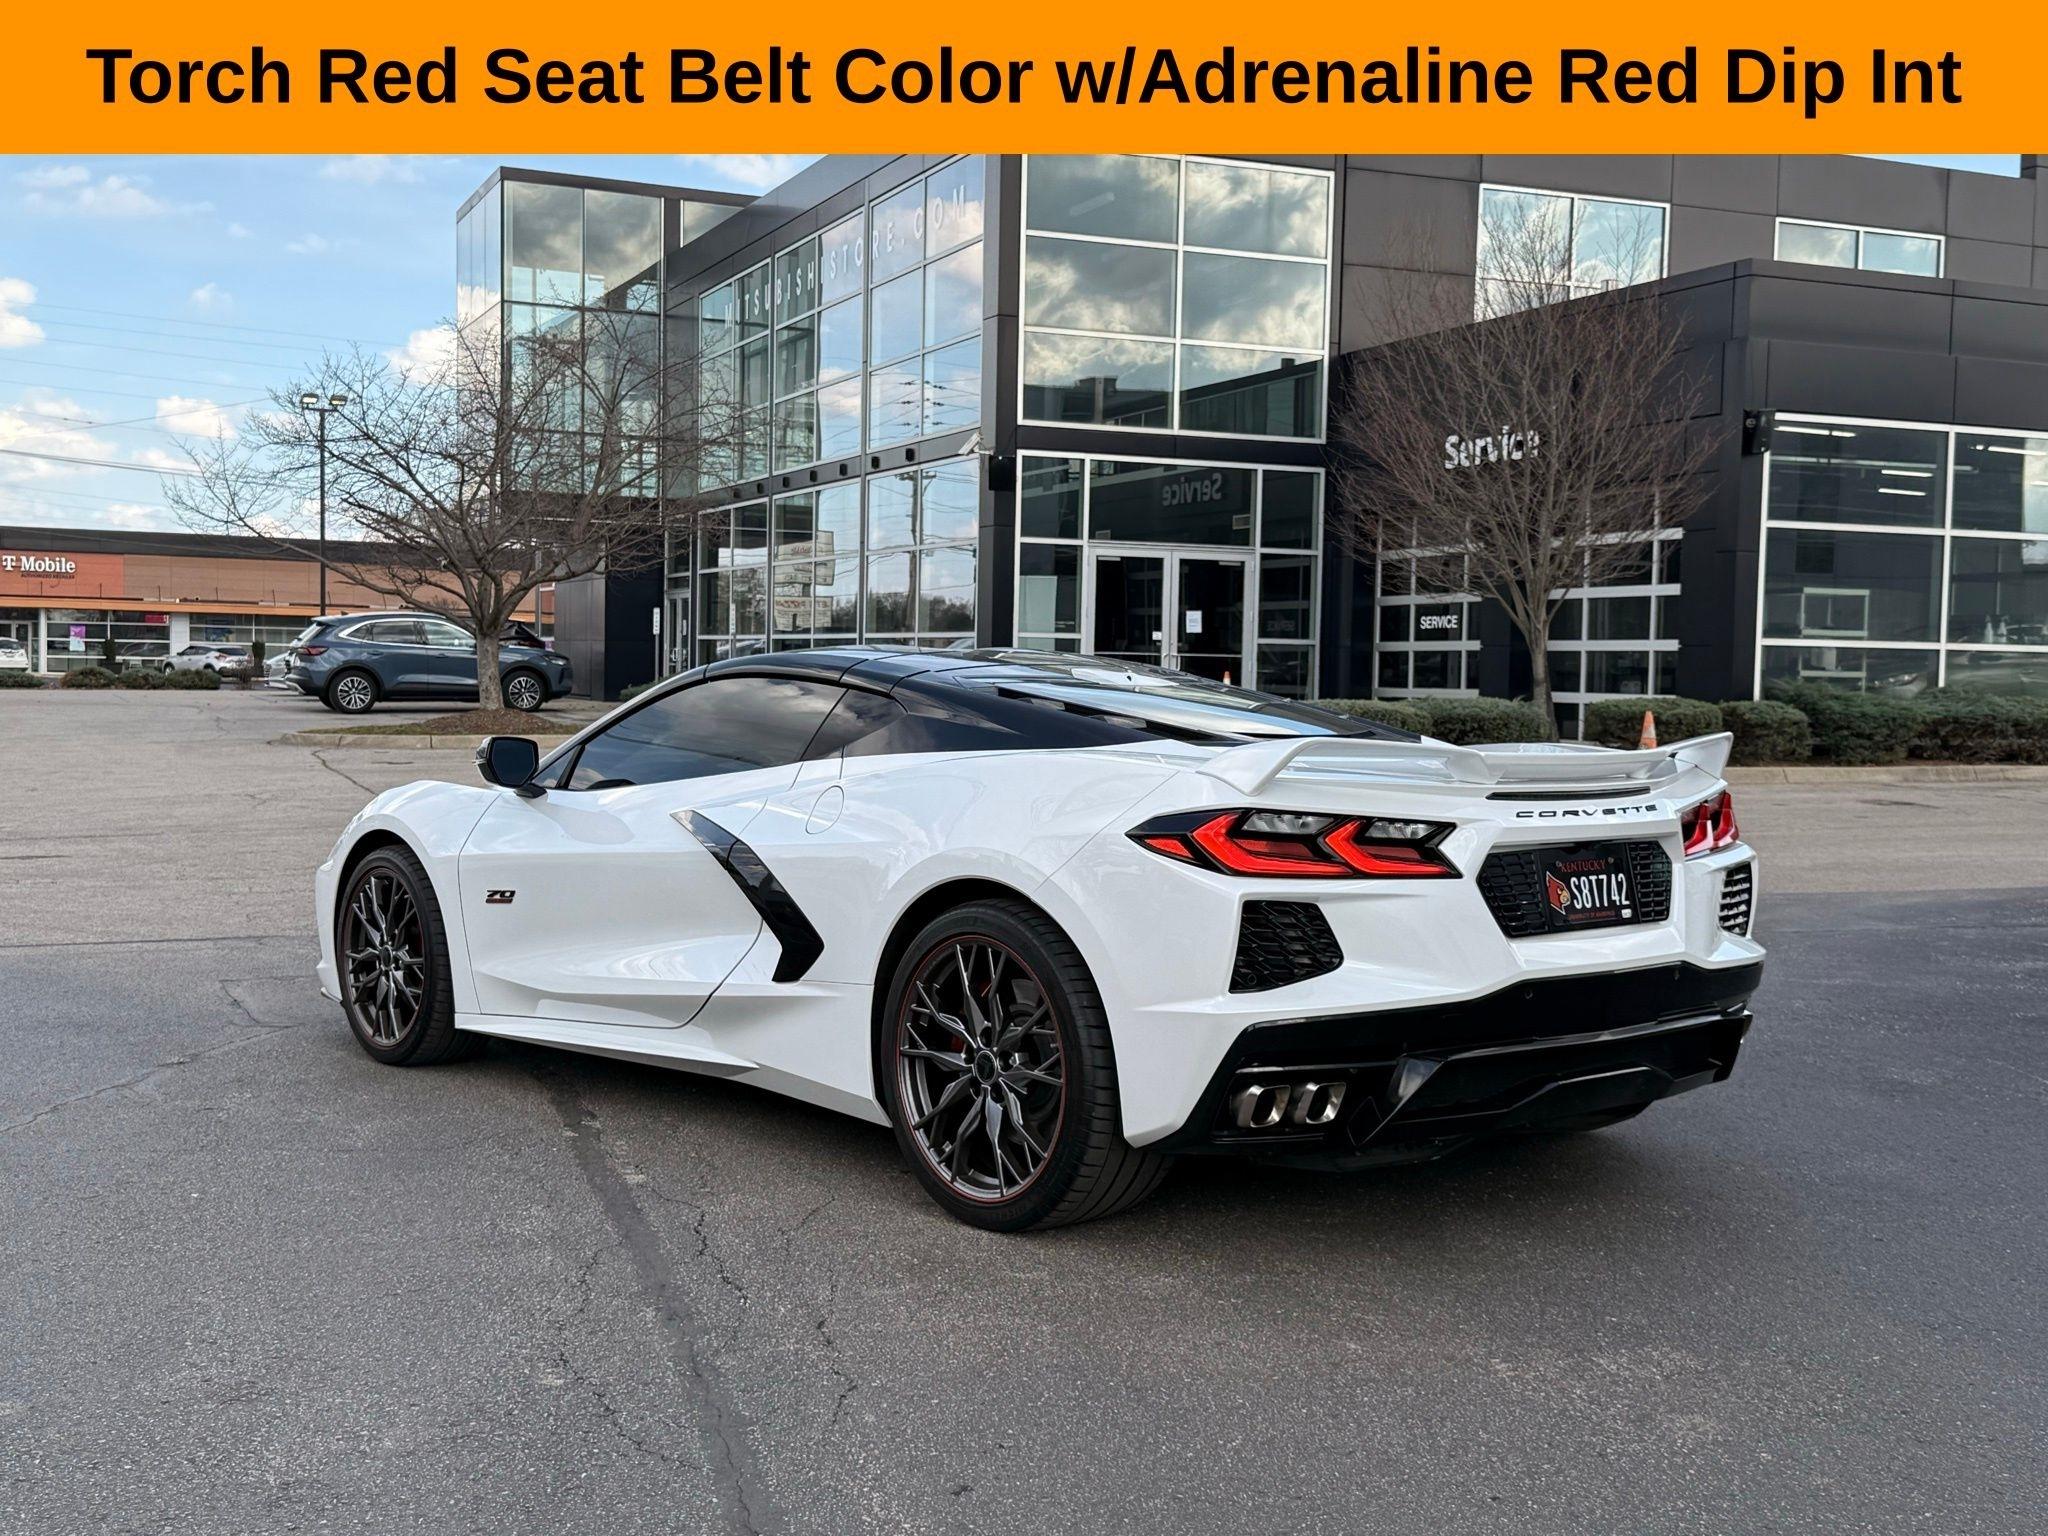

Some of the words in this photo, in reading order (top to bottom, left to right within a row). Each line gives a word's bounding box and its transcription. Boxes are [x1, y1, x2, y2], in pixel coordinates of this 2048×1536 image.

[1444, 425, 1540, 469] Service
[20, 555, 76, 573] Mobile
[1420, 615, 1458, 629] SERVICE
[1515, 804, 1658, 818] CORVETTE
[1560, 859, 1606, 872] KENTUCKY
[1570, 873, 1630, 909] S8T742
